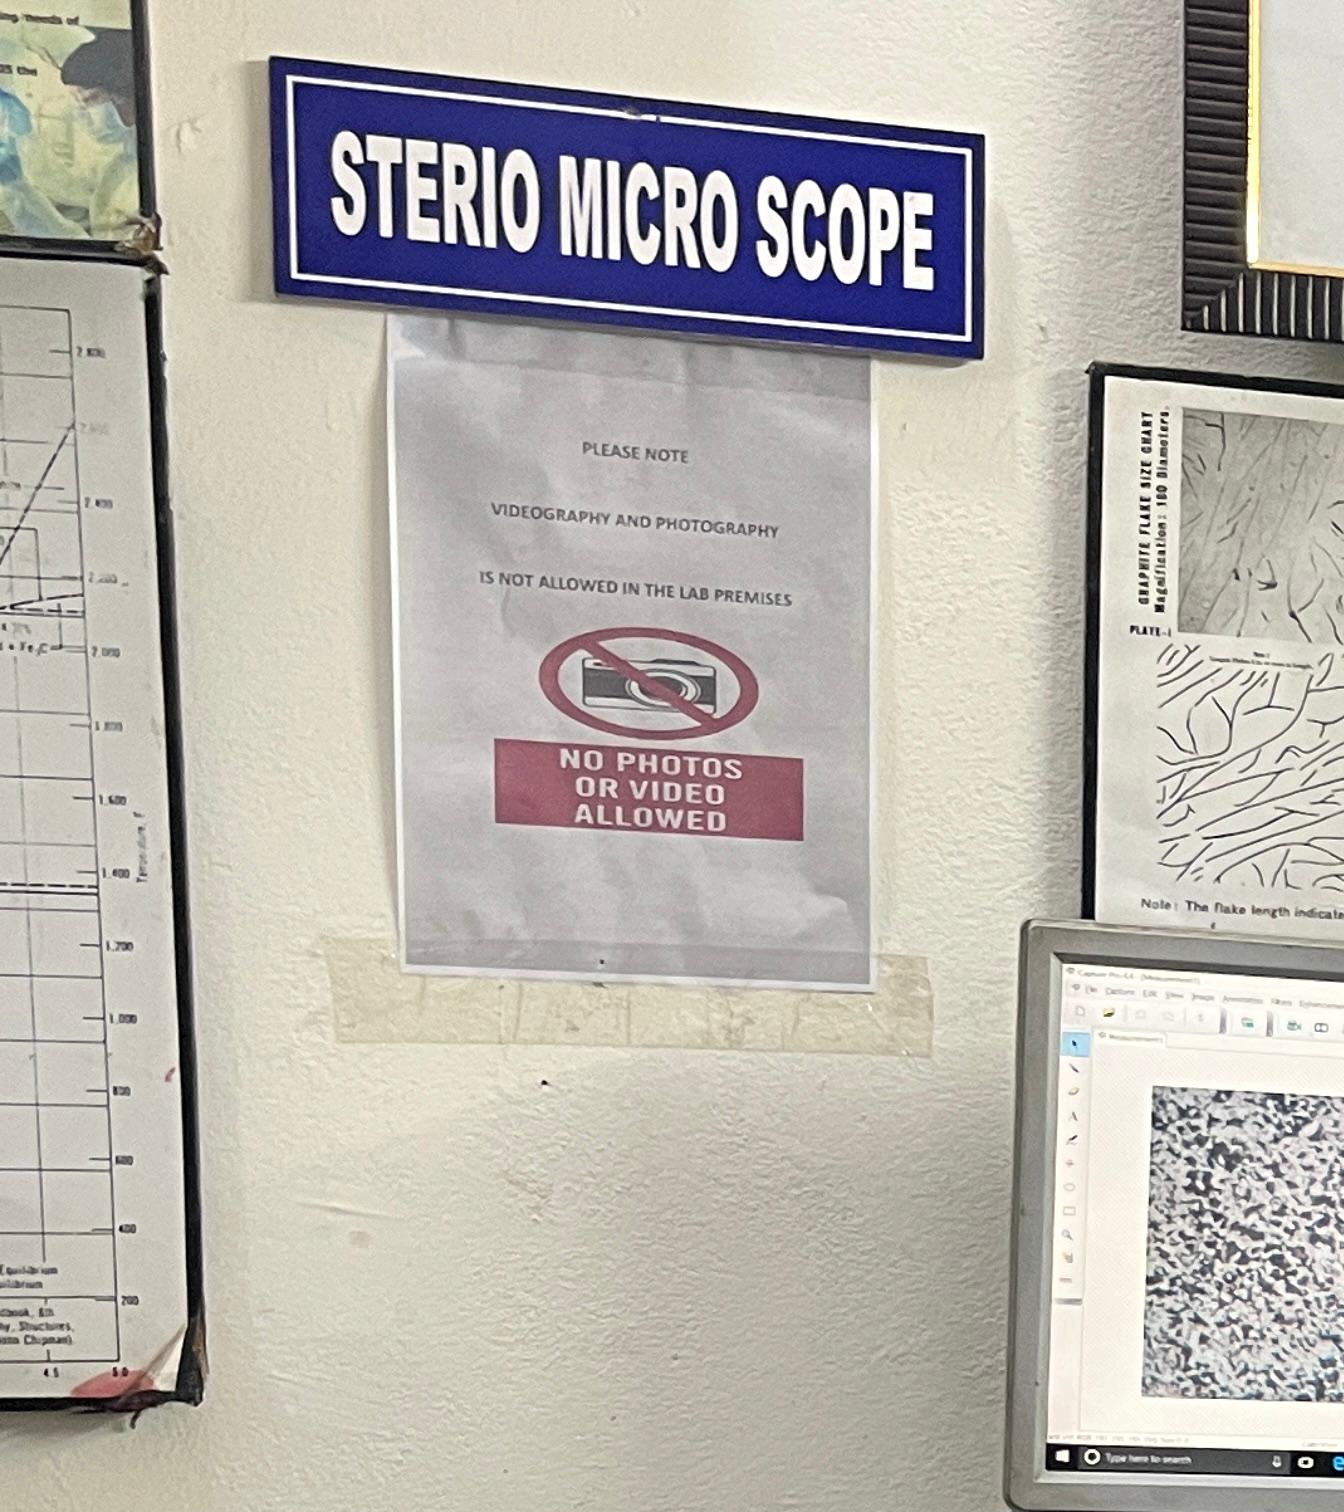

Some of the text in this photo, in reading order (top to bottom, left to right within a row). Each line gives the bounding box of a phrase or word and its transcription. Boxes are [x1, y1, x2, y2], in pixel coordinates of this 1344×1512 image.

[329, 130, 936, 291] STERIO MICRO SCOPE
[1141, 411, 1154, 455] CHART
[582, 441, 690, 464] PLEASE NOTE
[1140, 460, 1153, 489] SIZE
[491, 502, 781, 540] VIDEOGRAPHY AND PHOTOGRAPHY
[1138, 495, 1152, 536] FLAKE
[479, 570, 794, 608] IS NOT ALLOWED IN THE LAB PREMISES
[559, 747, 744, 781] NO PHOTOS
[575, 776, 726, 806] OR VIDEO
[573, 803, 728, 834] ALLOWED
[1185, 900, 1209, 913] The
[1214, 901, 1246, 915] flake
[1251, 903, 1290, 920] length
[1128, 1453, 1150, 1464] here
[1150, 1454, 1161, 1464] to
[1163, 1455, 1193, 1465] search
